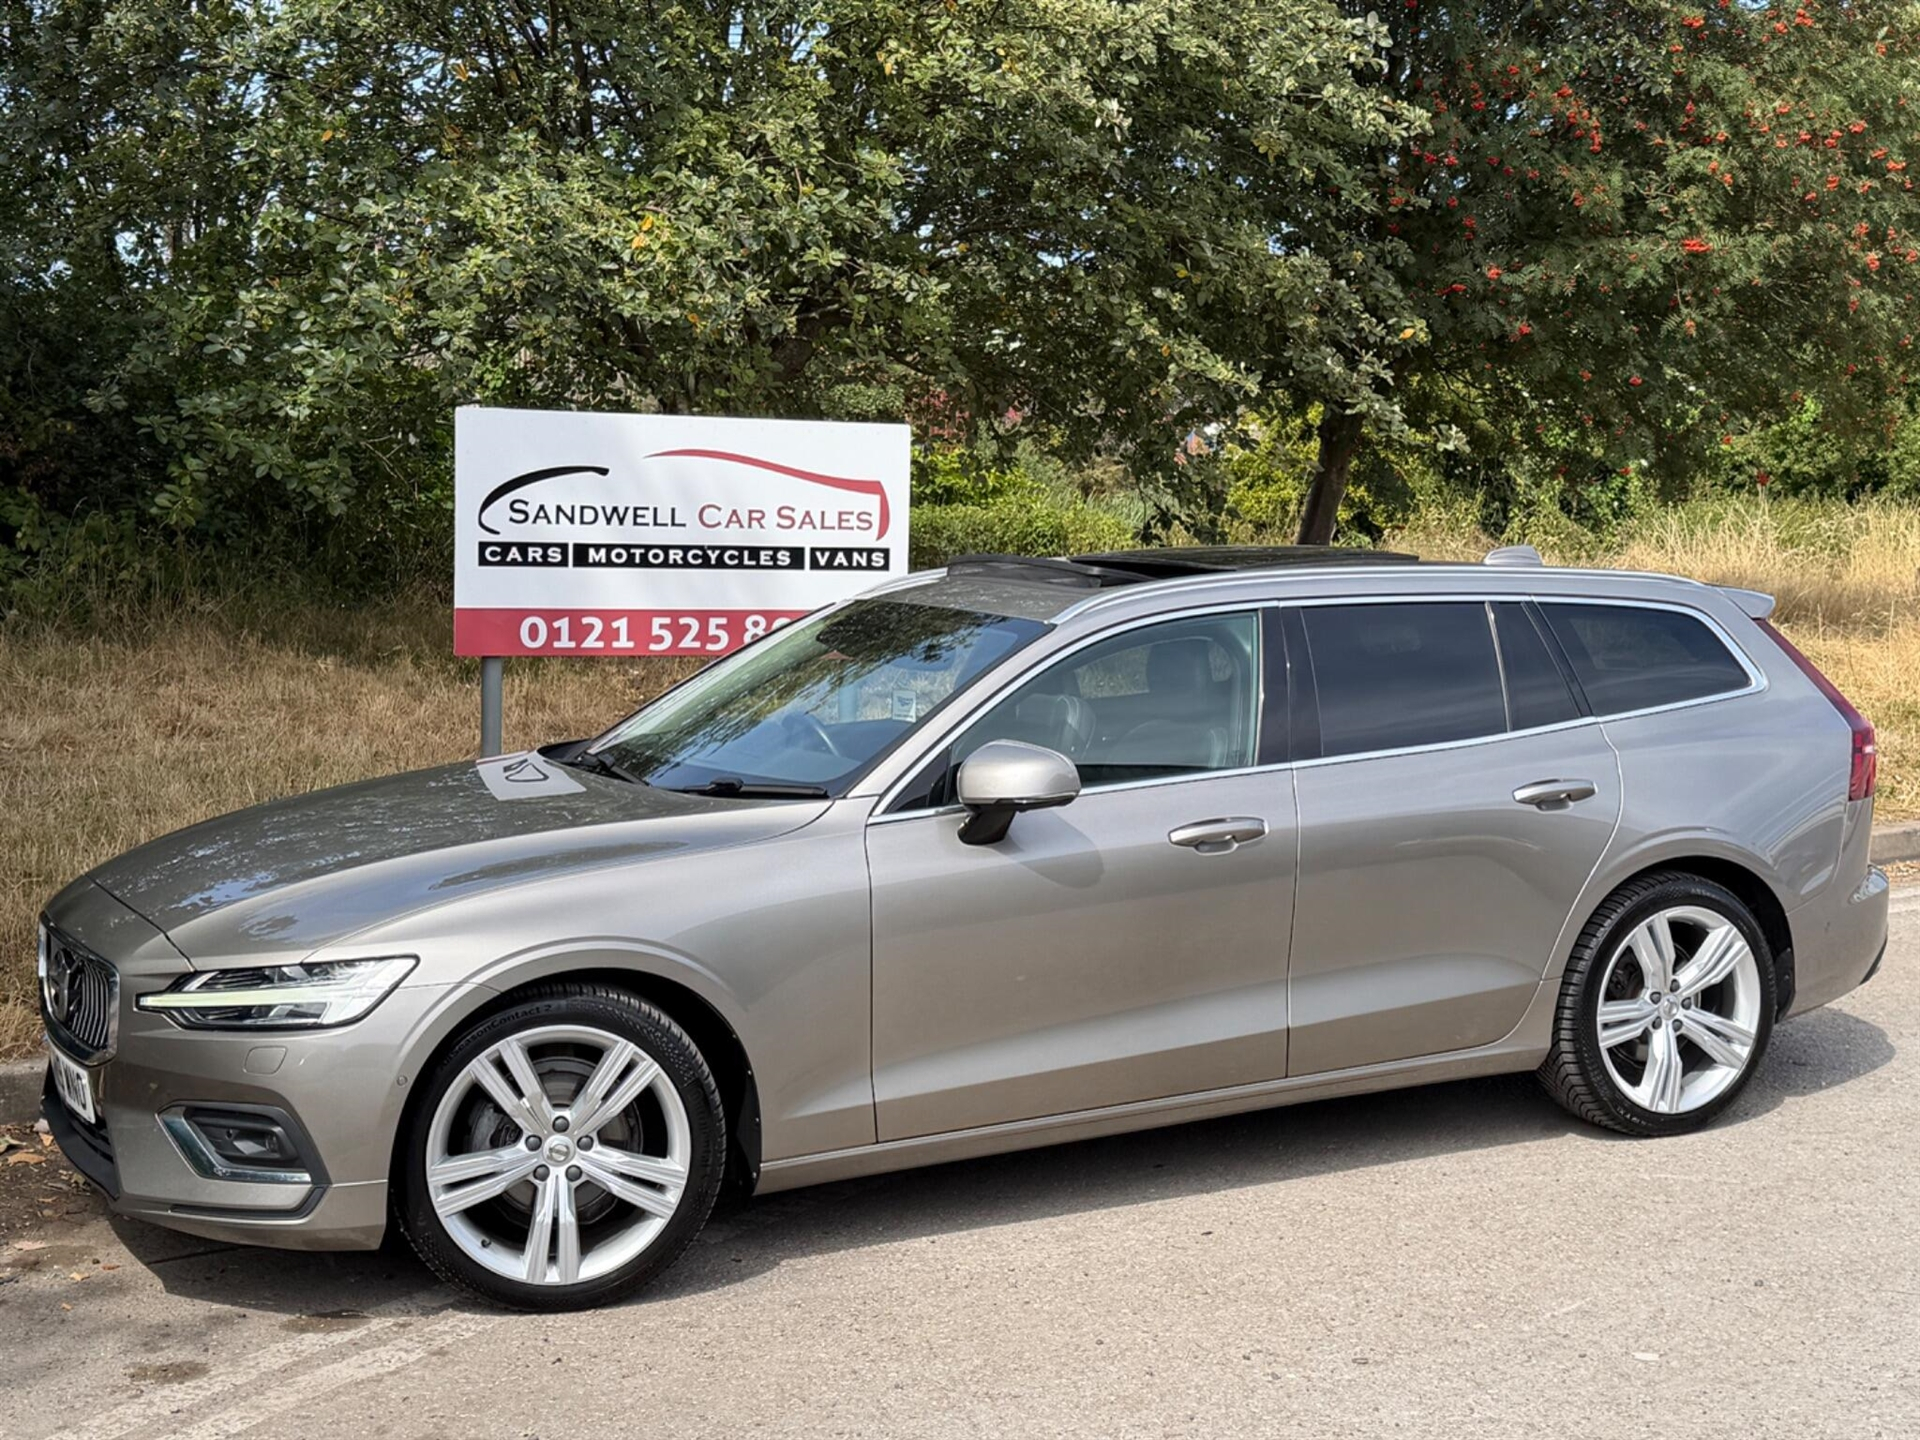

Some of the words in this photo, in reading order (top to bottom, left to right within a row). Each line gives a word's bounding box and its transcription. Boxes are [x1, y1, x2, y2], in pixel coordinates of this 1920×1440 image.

[698, 504, 766, 530] CAR
[776, 507, 873, 531] SALES
[484, 546, 563, 563] CARS
[588, 549, 791, 567] MOTORCYCLES
[816, 551, 886, 567] VANS
[519, 616, 635, 649] 0121
[648, 617, 730, 651] 525
[743, 614, 791, 645] 8
